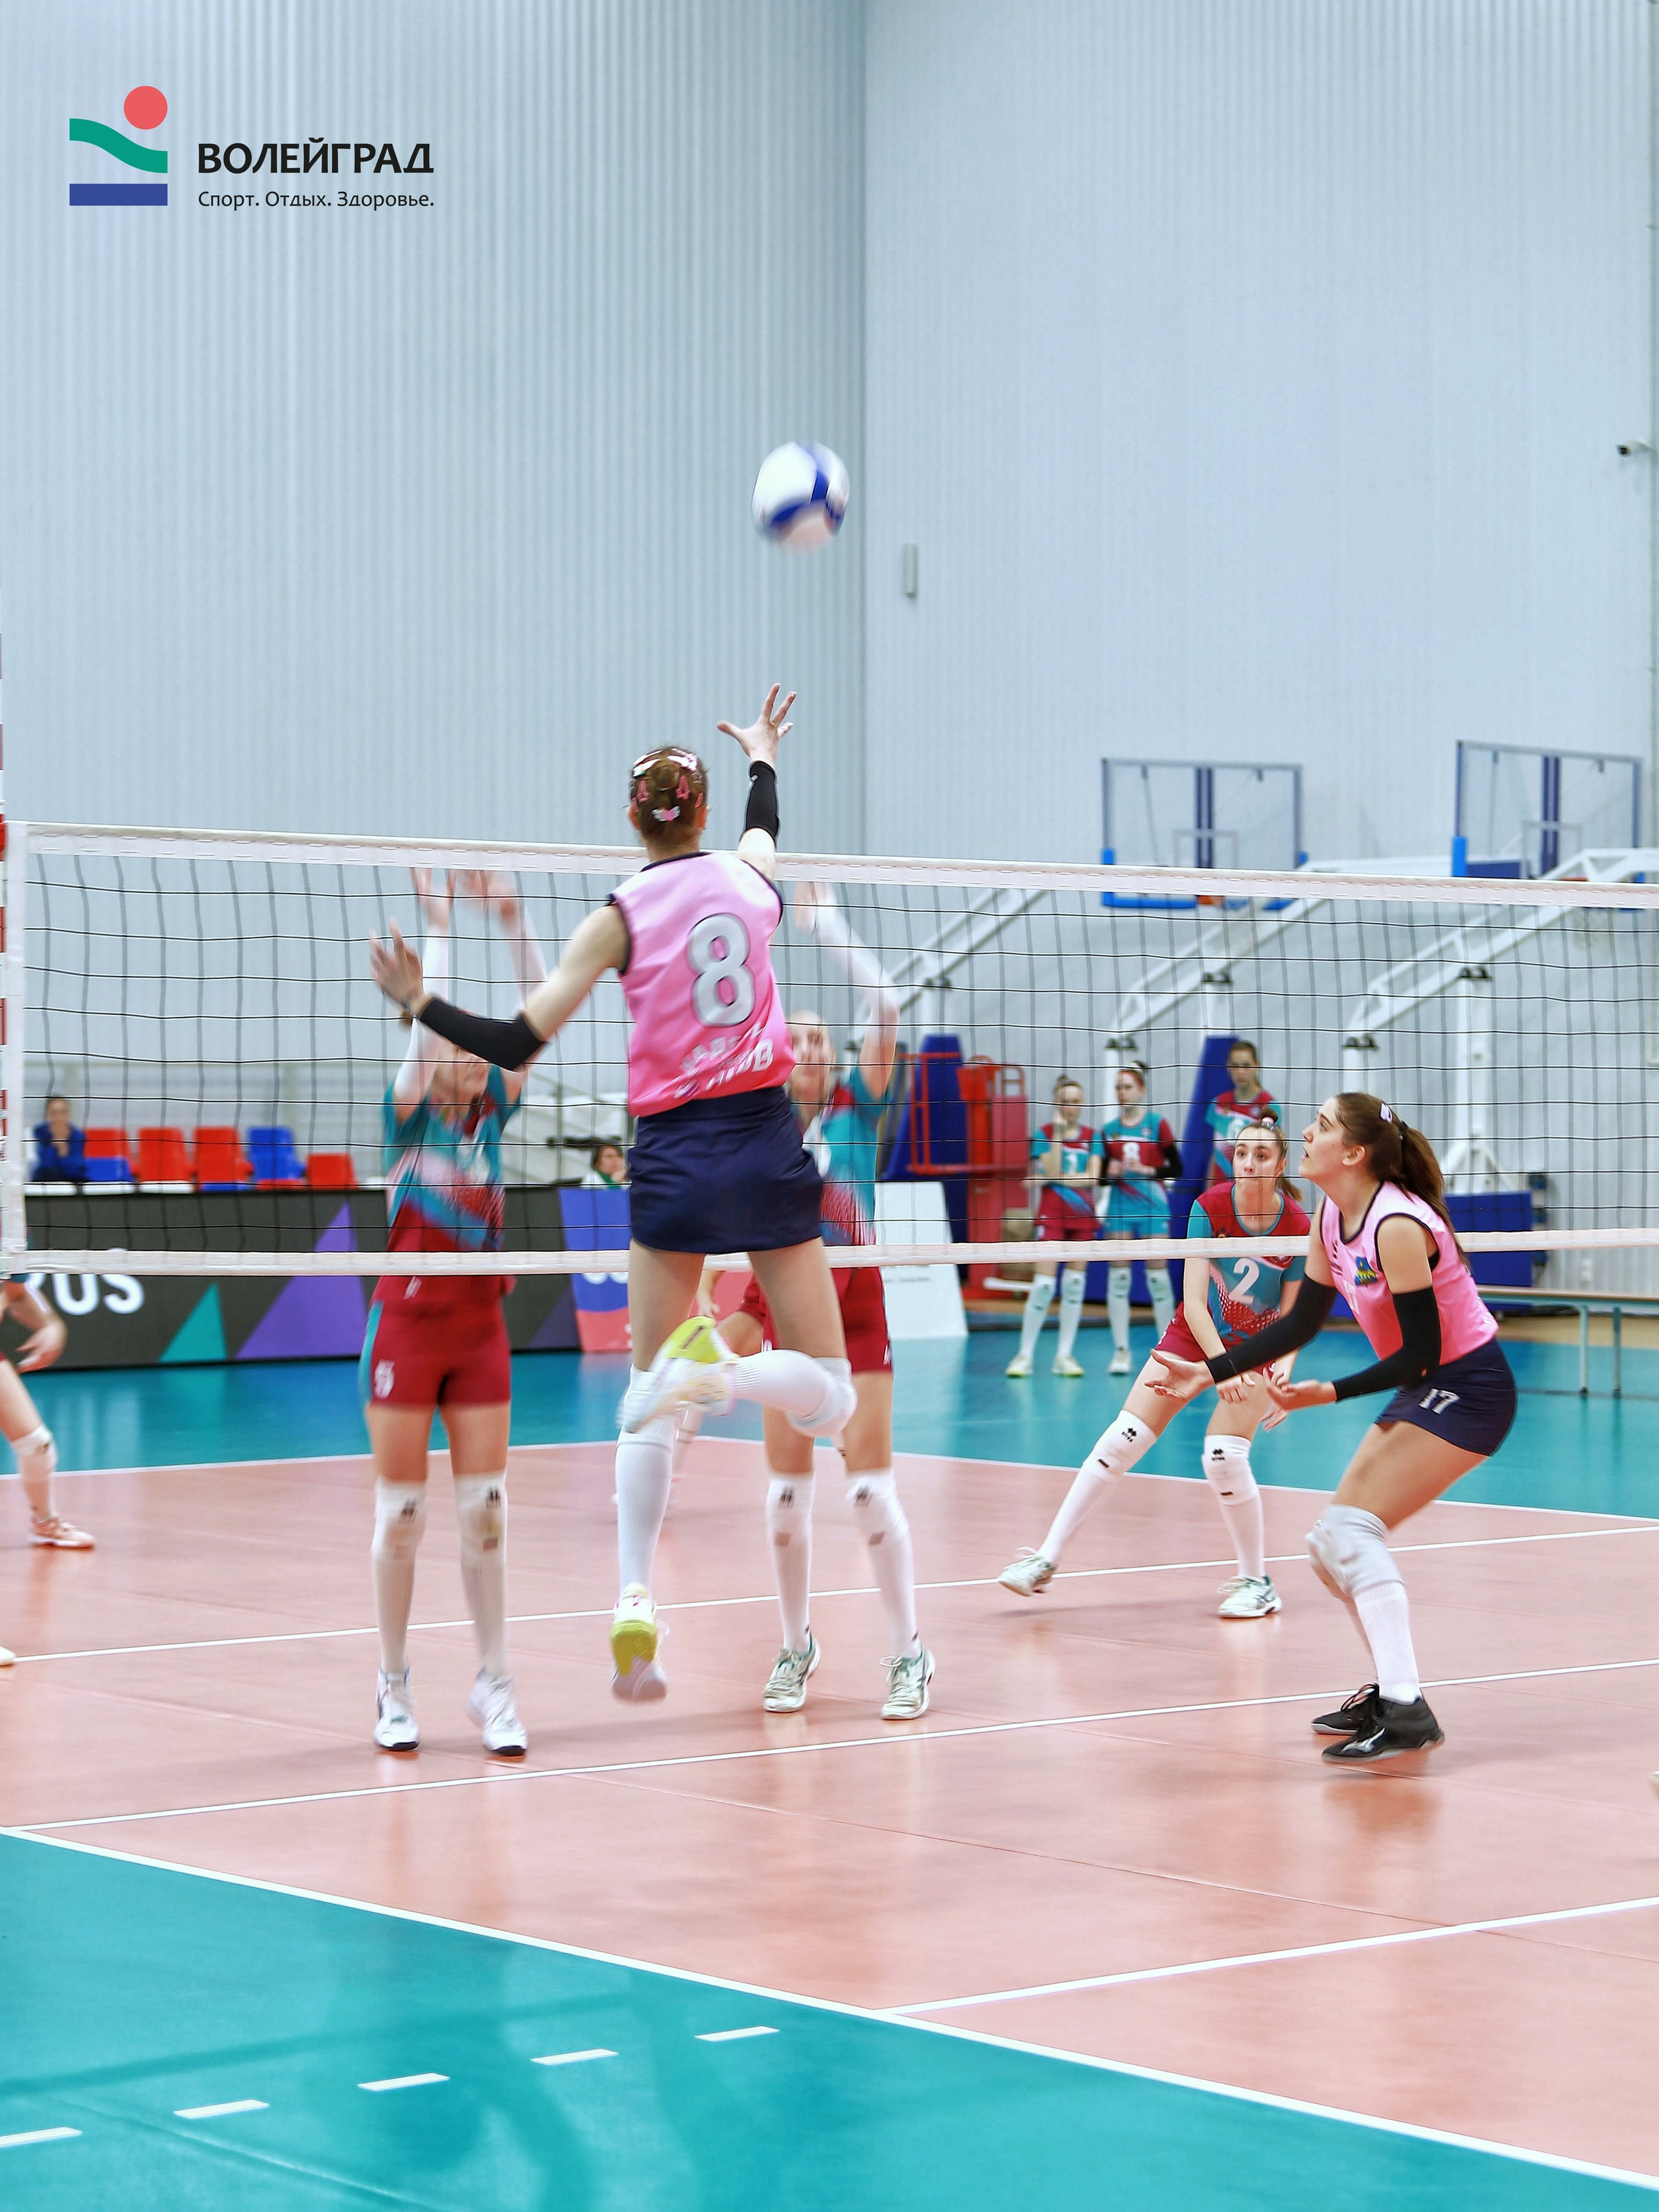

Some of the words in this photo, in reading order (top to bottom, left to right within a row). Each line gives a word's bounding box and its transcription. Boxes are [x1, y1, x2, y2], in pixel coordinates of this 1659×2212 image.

[687, 913, 756, 1027] 8
[1229, 1257, 1259, 1303] 2
[1417, 1388, 1460, 1415] 17
